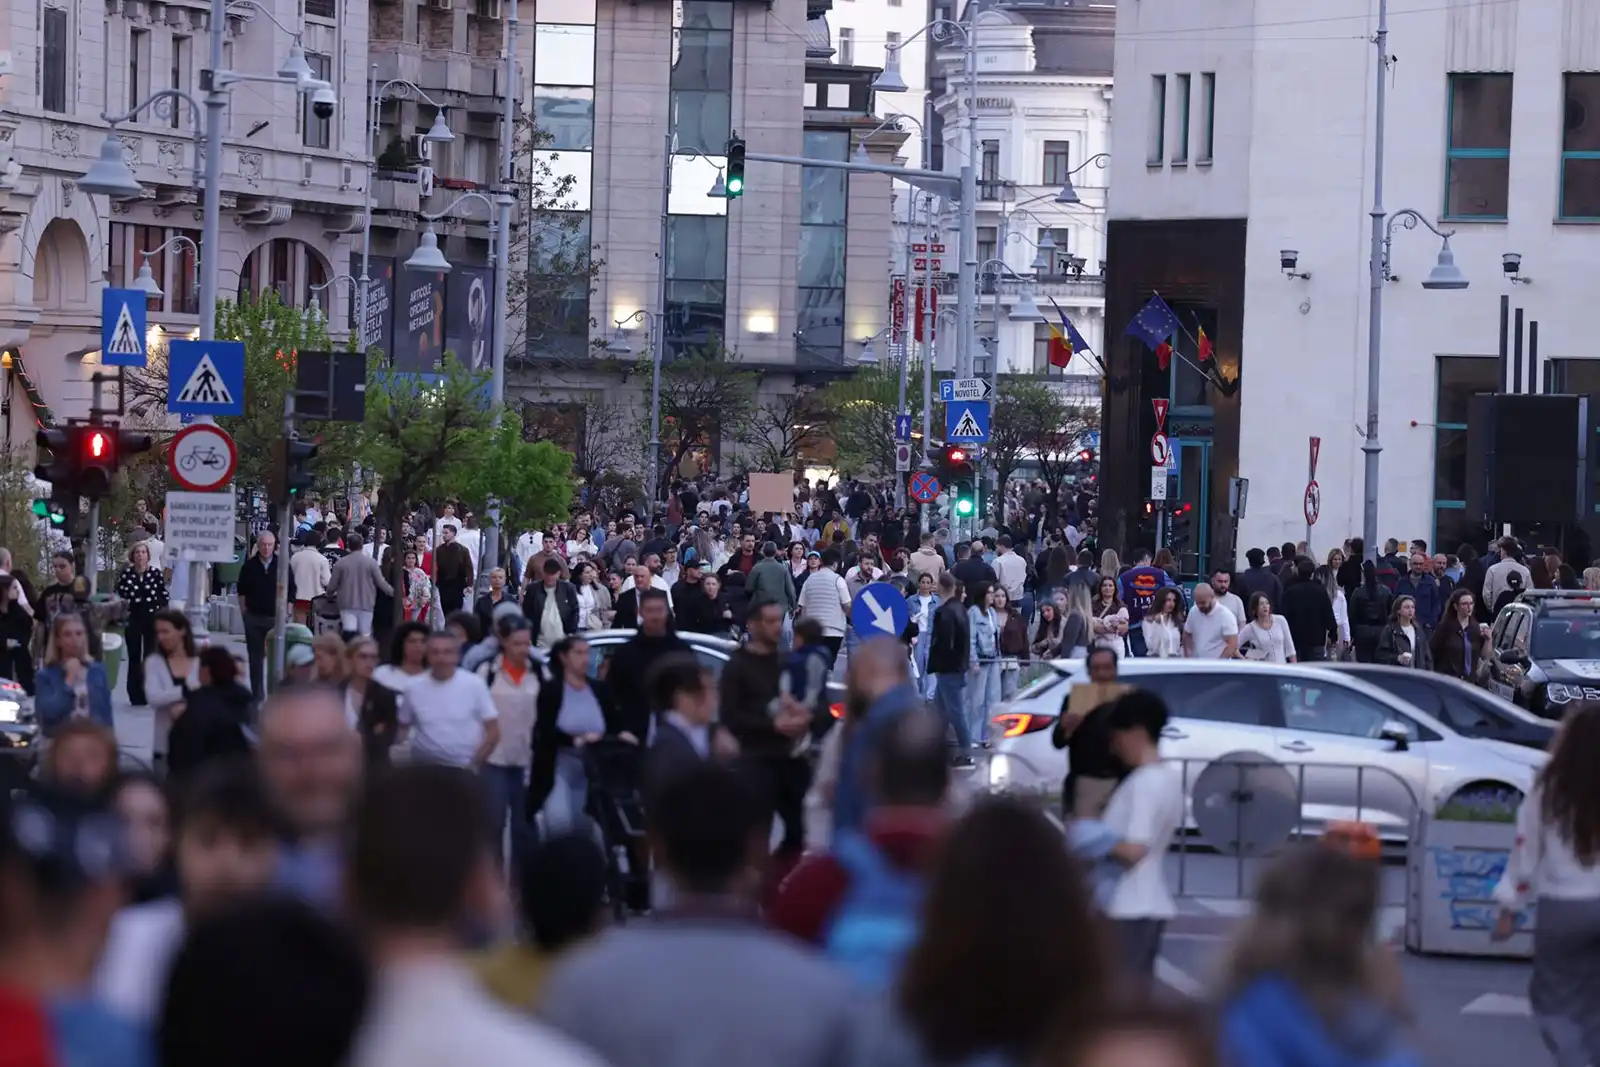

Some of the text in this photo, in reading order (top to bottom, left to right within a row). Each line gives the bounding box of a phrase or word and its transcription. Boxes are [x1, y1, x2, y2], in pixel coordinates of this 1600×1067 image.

[409, 283, 432, 303] ARTICOLE
[959, 380, 977, 388] HOTEL
[955, 389, 980, 398] NOVOTEL
